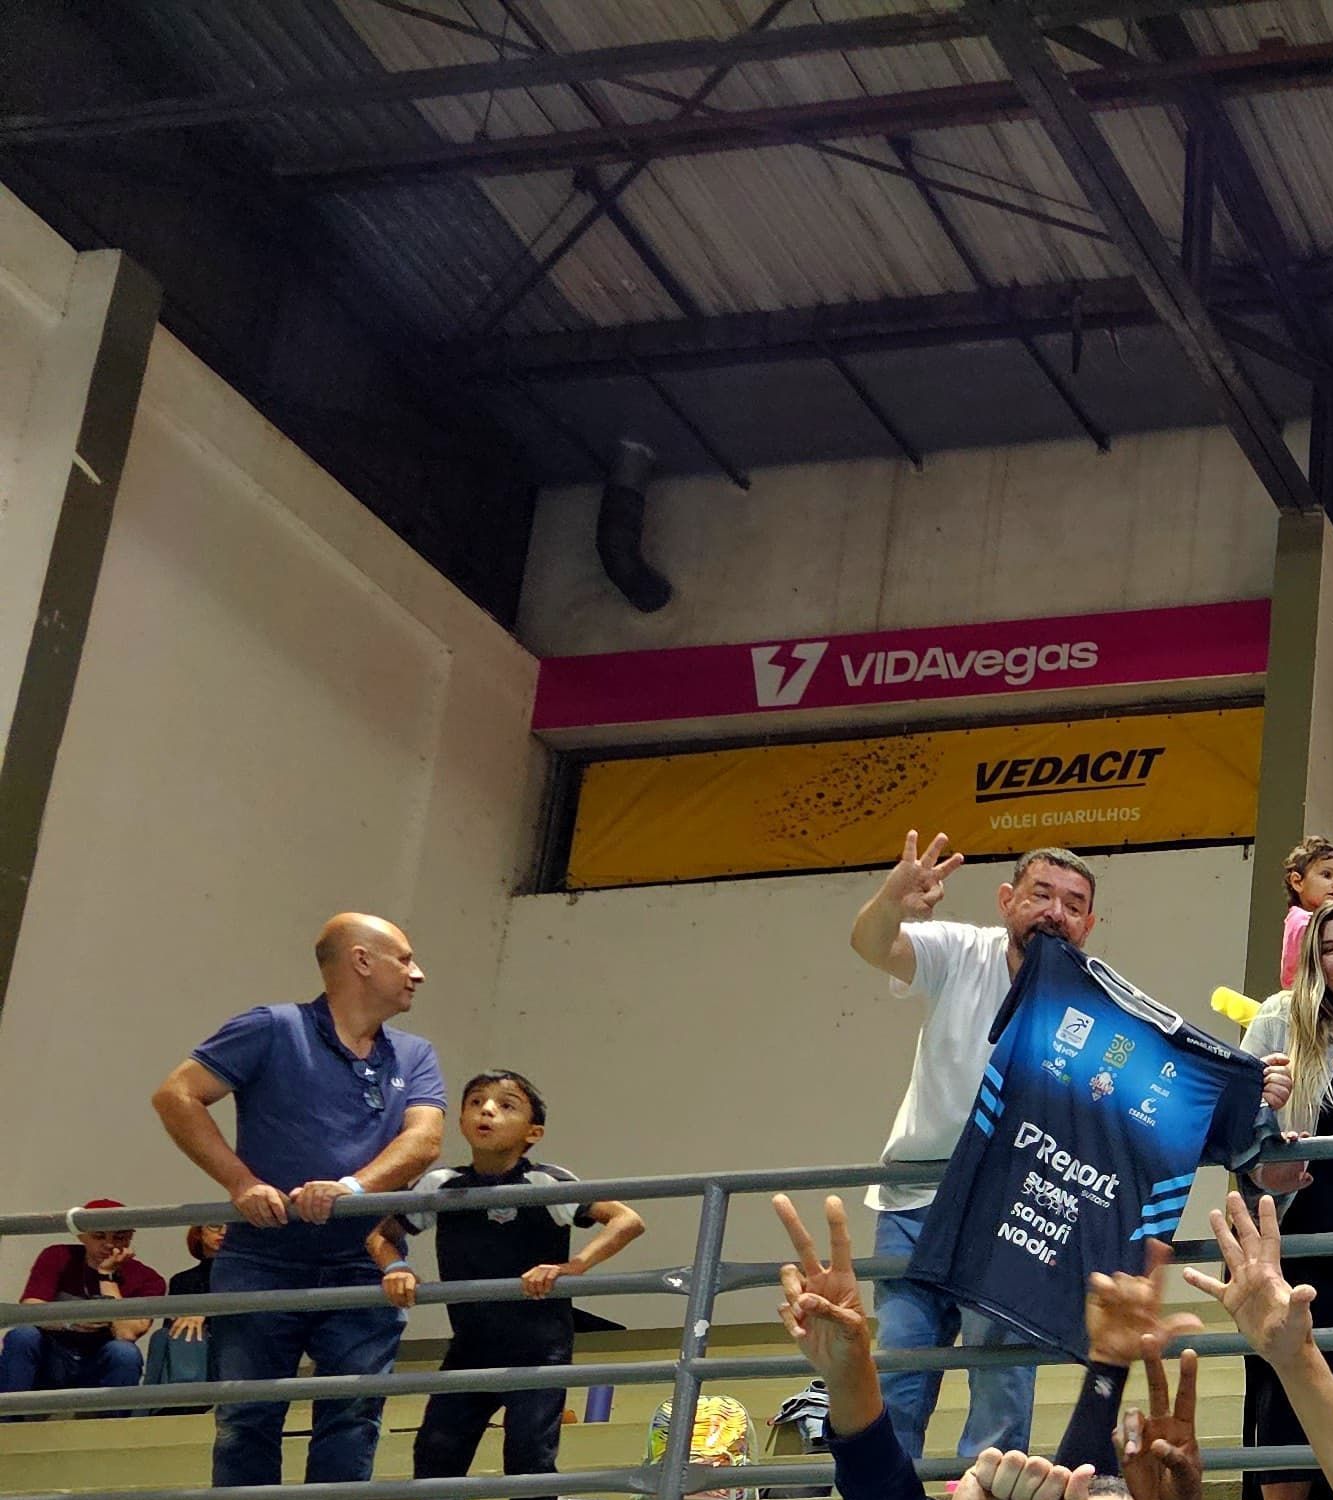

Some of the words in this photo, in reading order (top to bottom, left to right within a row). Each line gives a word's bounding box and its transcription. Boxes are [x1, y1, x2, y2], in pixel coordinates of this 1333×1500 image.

[841, 641, 1099, 686] VIDAvegas
[975, 748, 1165, 792] VEDACIT
[1041, 806, 1141, 826] GUARULHOS
